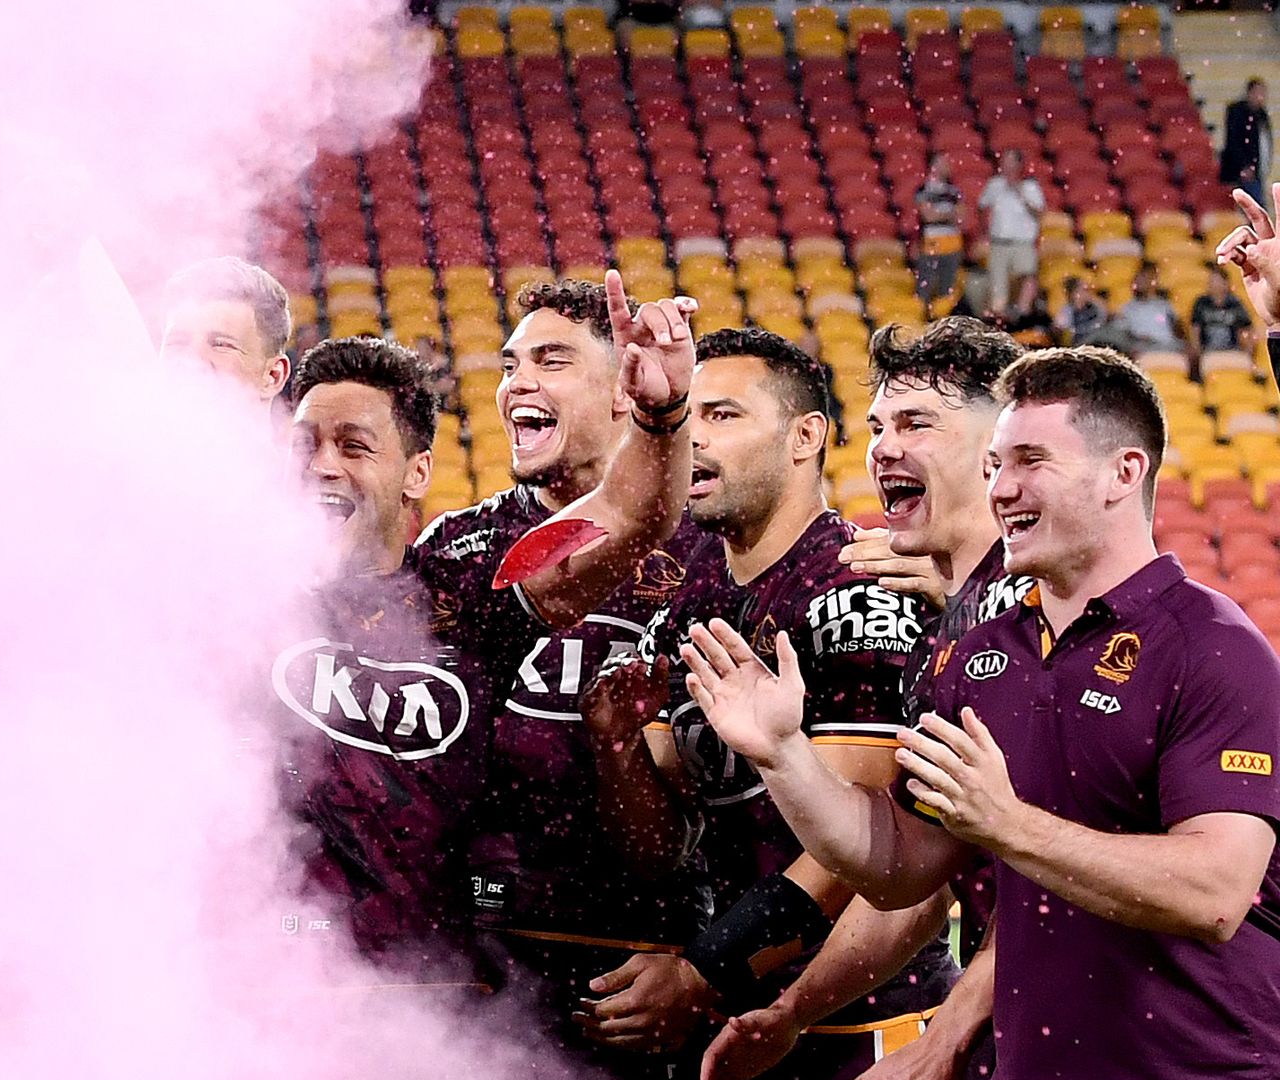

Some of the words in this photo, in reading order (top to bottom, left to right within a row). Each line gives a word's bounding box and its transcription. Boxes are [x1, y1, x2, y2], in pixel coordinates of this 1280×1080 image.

[973, 655, 1002, 675] KIA
[312, 653, 443, 740] KIA
[1080, 689, 1114, 712] ISC
[1225, 754, 1267, 771] XXXX
[308, 920, 332, 931] ISC
